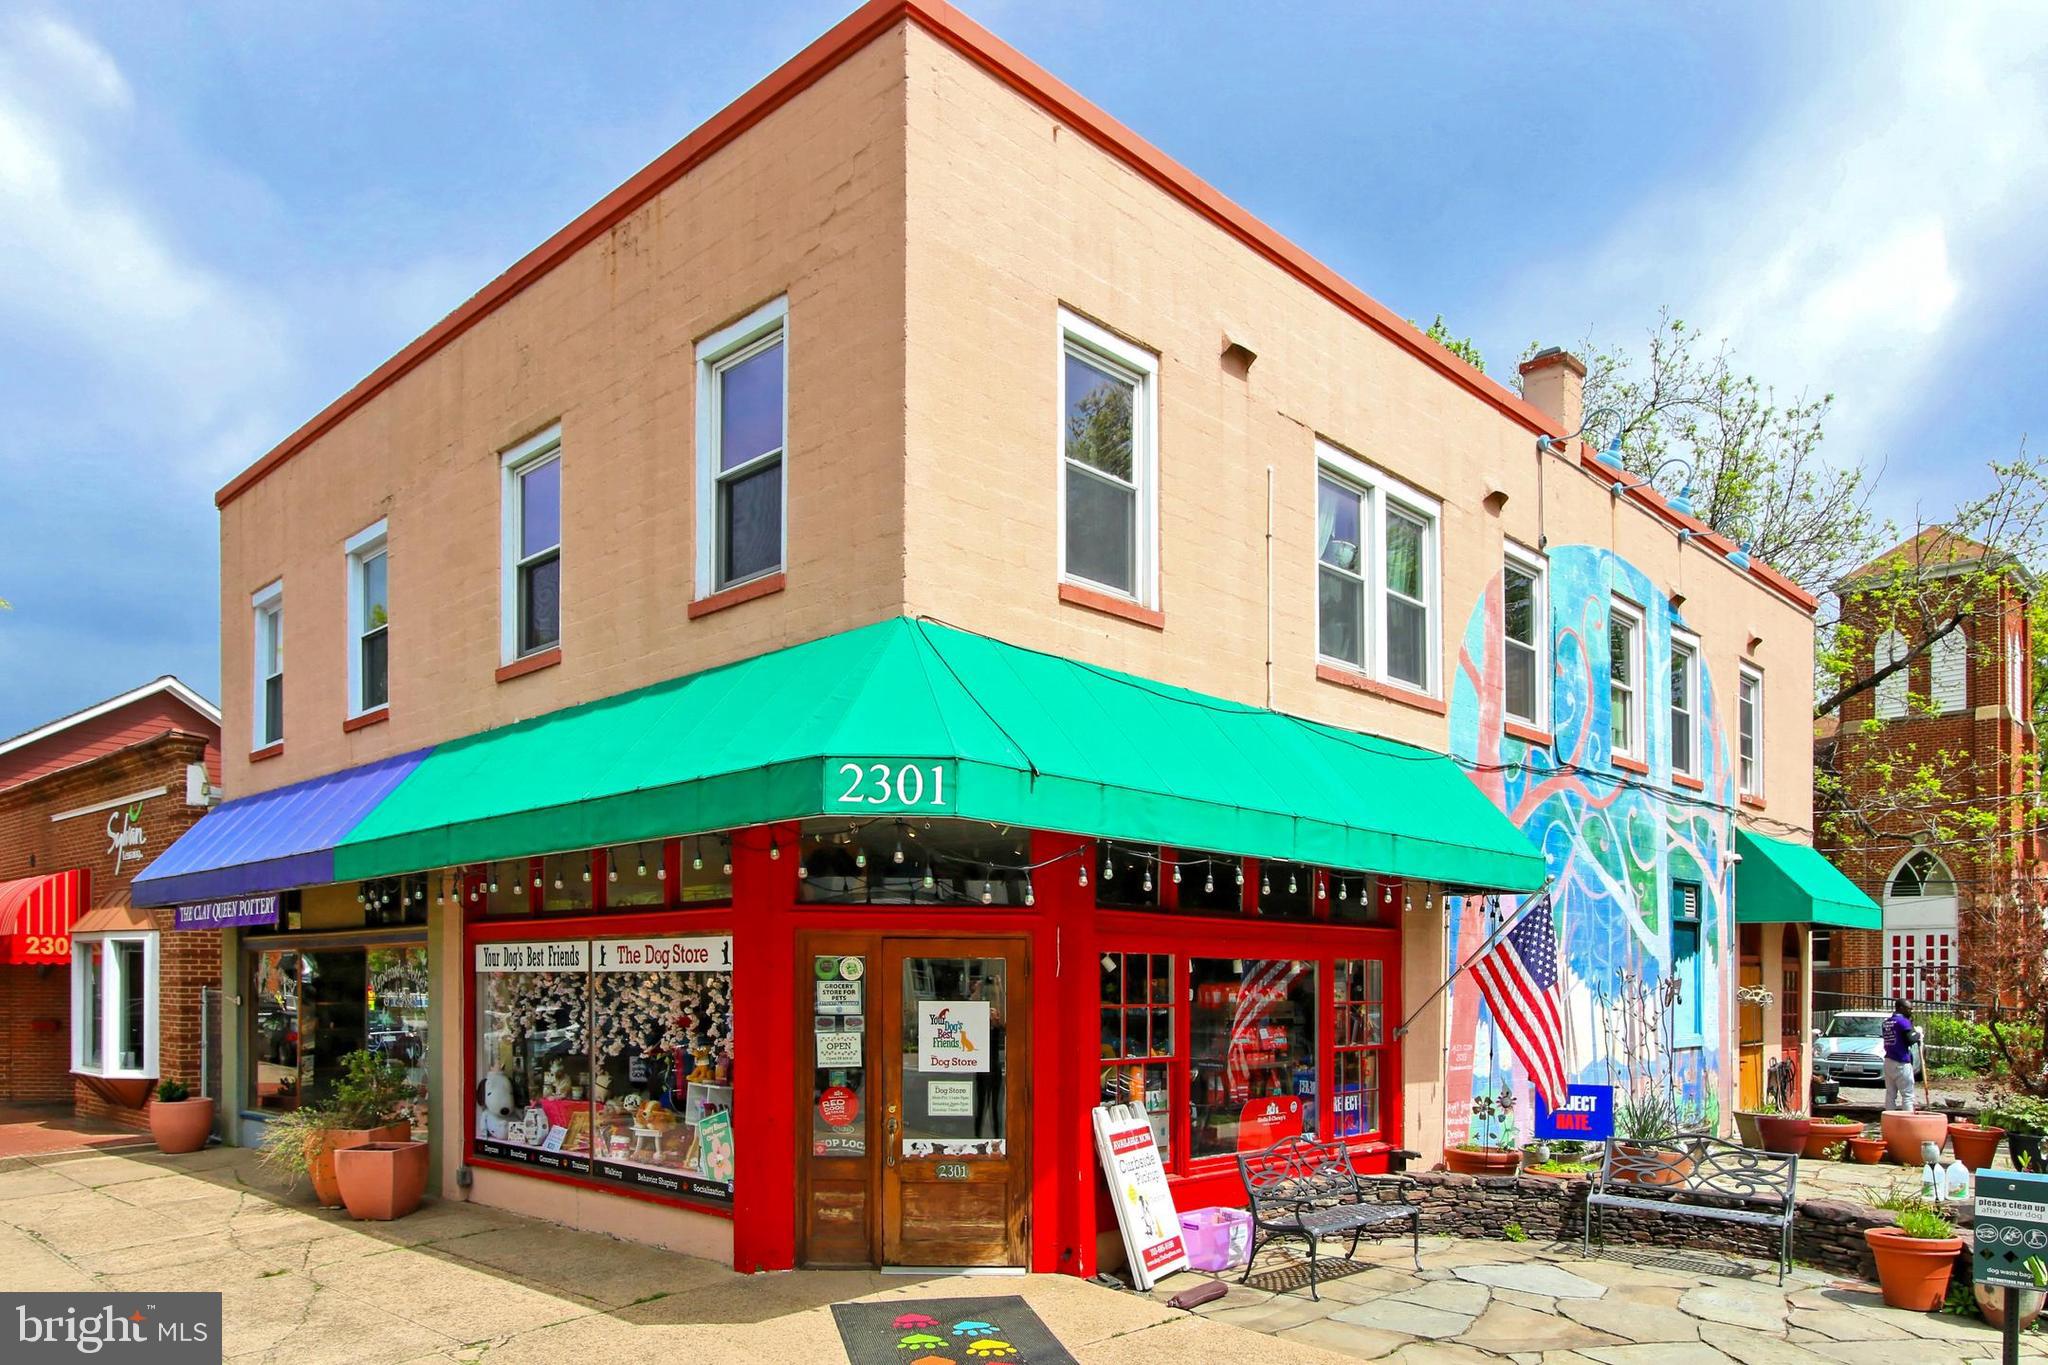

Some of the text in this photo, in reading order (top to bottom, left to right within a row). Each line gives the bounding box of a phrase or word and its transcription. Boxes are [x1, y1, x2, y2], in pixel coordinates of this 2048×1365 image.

[838, 763, 946, 805] 2301
[180, 896, 276, 922] THE CLAY QUEEN POTTERY
[25, 936, 71, 955] 230
[483, 944, 580, 971] Your Dog's Best Friends
[617, 943, 709, 970] The Dog Store
[929, 1014, 945, 1025] Your
[937, 1028, 953, 1040] Best
[944, 1020, 963, 1034] Dog's
[826, 1042, 852, 1050] OPEN
[932, 1037, 960, 1048] Friends
[930, 1057, 978, 1068] Dog Store
[935, 1087, 948, 1095] Dog
[1334, 1095, 1358, 1112] REECT
[1561, 1095, 1597, 1112] JECT
[841, 1138, 865, 1149] LOC
[1119, 1152, 1156, 1174] Curbside
[603, 1166, 623, 1179] Walking
[938, 1164, 967, 1178] 2301
[637, 1173, 678, 1189] Behavior Shaping
[693, 1183, 726, 1197] Socialization
[1978, 1198, 2046, 1213] please clean up
[2003, 1209, 2023, 1217] your
[2025, 1211, 2043, 1220] dog
[1986, 1267, 2034, 1279] dog waste bags
